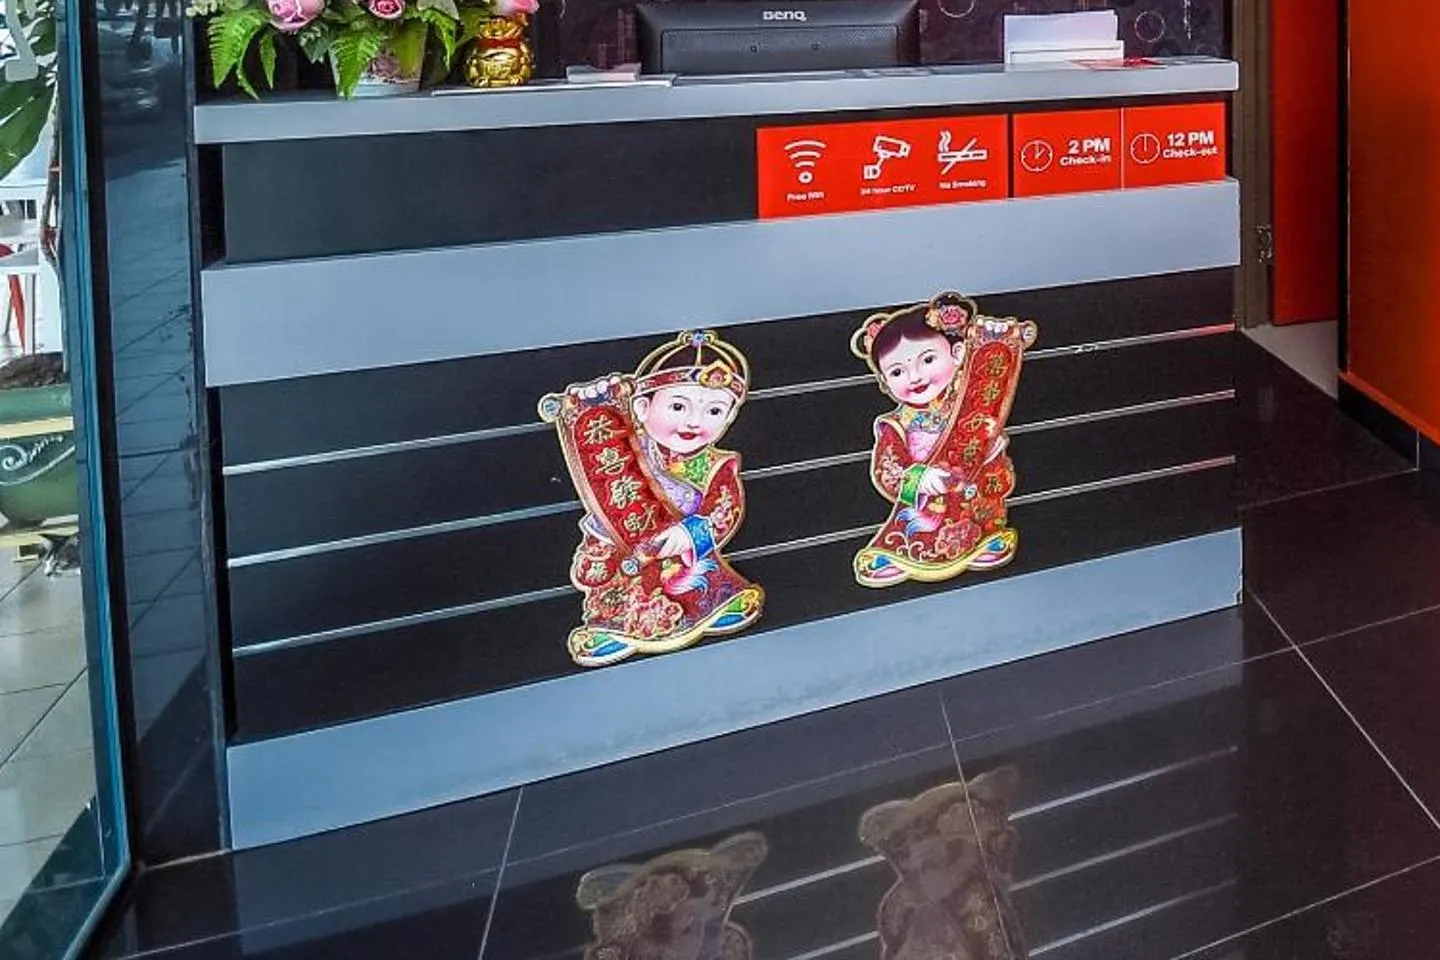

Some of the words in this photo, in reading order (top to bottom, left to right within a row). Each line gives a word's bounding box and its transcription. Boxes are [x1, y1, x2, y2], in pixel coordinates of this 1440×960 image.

[1068, 140, 1080, 154] 2
[1082, 137, 1111, 153] PM
[1167, 132, 1185, 147] 12
[1188, 130, 1214, 146] PM
[1162, 145, 1218, 159] Check-out
[1060, 154, 1112, 166] Check-in
